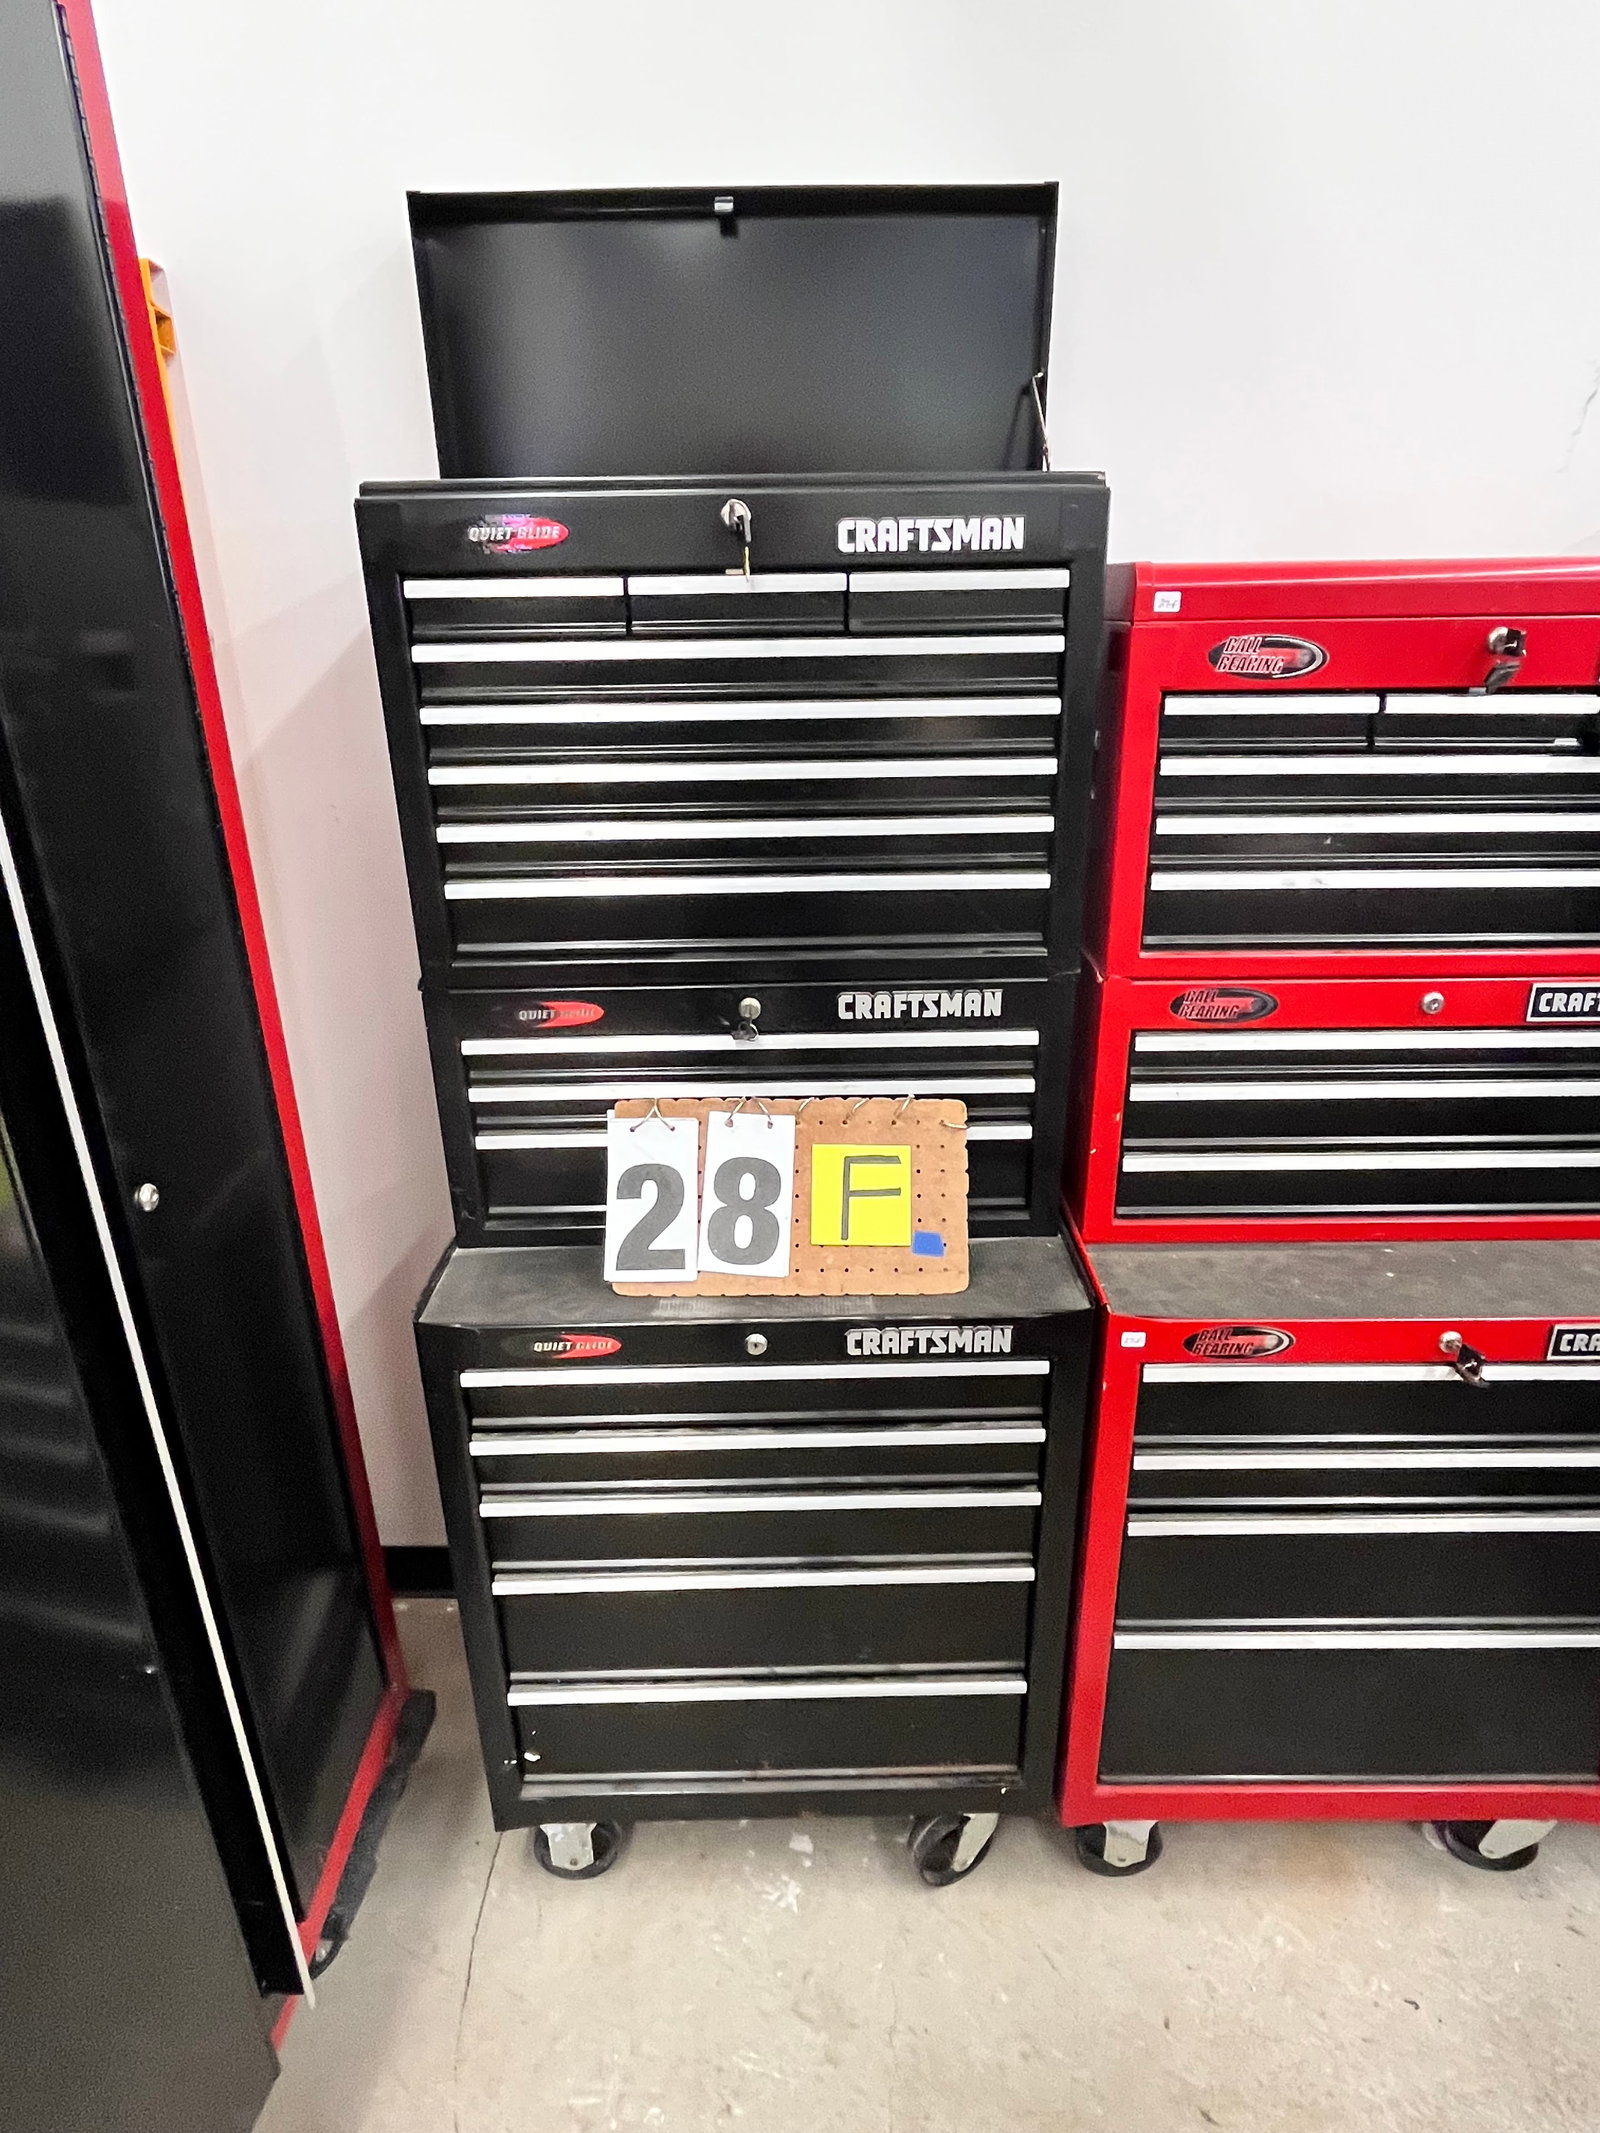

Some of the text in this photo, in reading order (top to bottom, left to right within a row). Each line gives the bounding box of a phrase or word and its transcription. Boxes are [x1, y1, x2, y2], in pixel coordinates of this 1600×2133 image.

[468, 526, 560, 542] QUIET GLIDE
[836, 515, 1025, 553] CRAFTSMAN
[1216, 655, 1284, 674] BEARING
[837, 990, 1003, 1019] CRAFTSMAN
[1538, 992, 1600, 1012] CRAF
[519, 1009, 556, 1021] QUIET
[616, 1155, 901, 1271] 28 F
[533, 1342, 573, 1352] QUIET
[846, 1326, 1013, 1356] CRAFTSMAN
